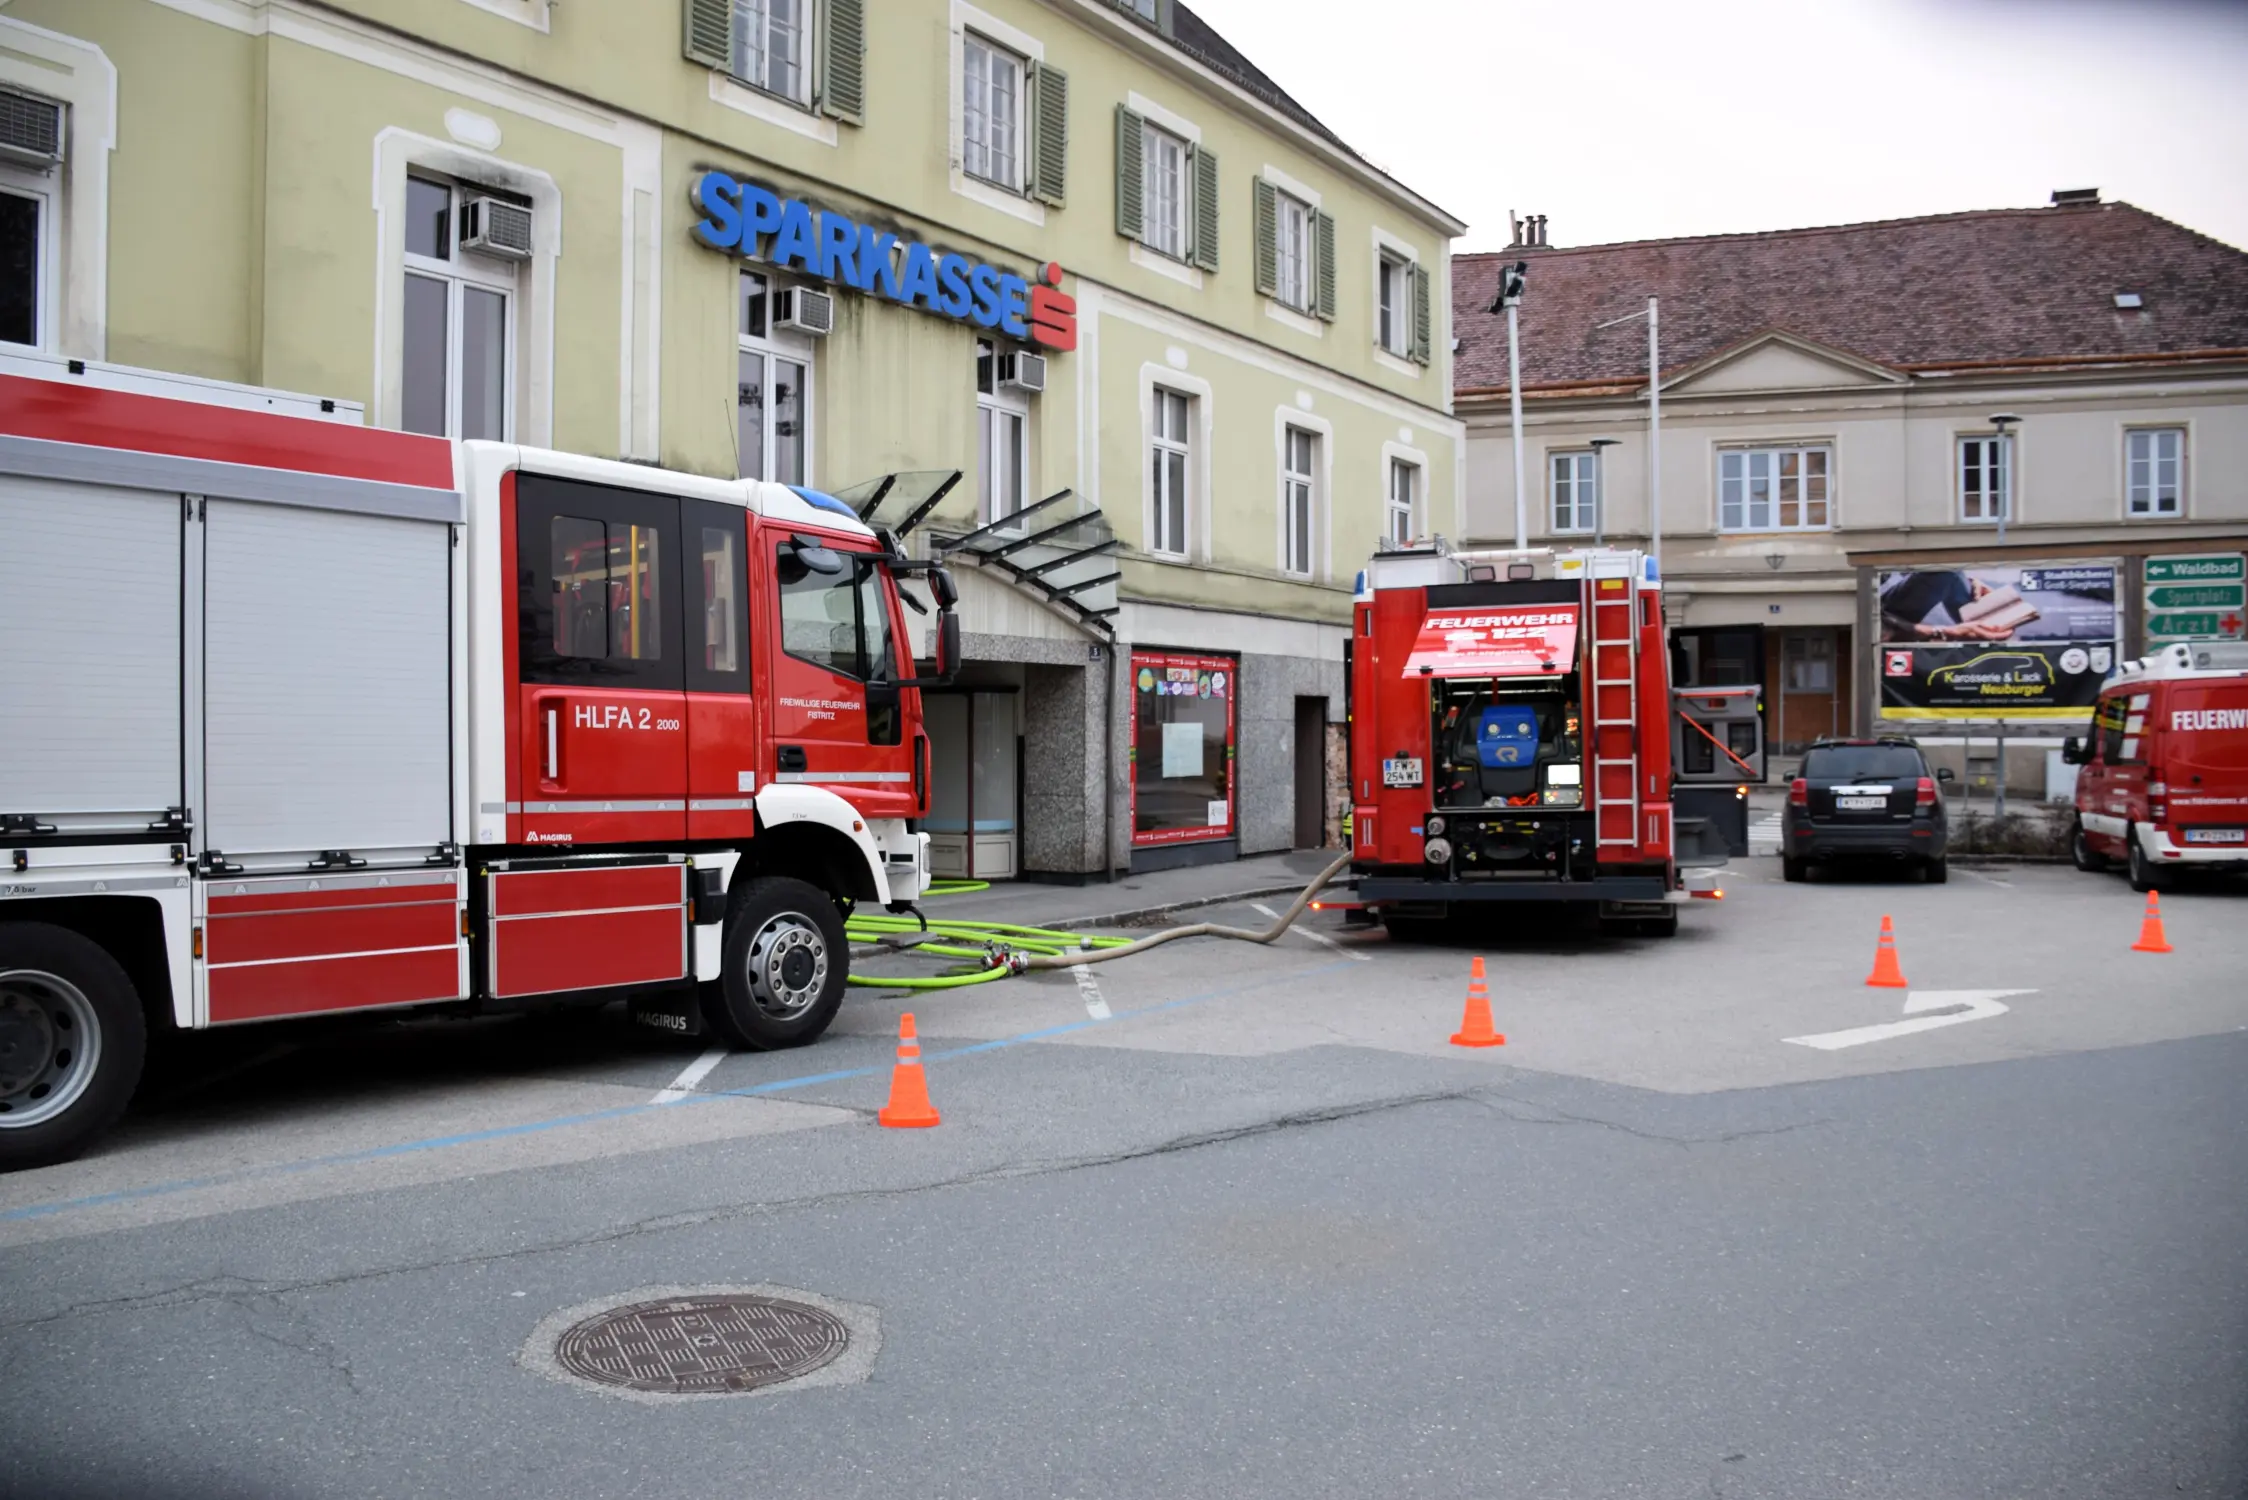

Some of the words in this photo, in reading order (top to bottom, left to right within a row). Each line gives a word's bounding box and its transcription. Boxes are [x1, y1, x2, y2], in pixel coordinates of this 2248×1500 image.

[698, 171, 1028, 337] SPARKASSE
[2171, 562, 2239, 576] Waldbad
[2167, 588, 2231, 606] Sportplatz
[1425, 613, 1574, 630] FEUERWEHR
[2161, 615, 2209, 633] Arzt
[1491, 626, 1549, 640] 122
[1944, 671, 2002, 683] Karosserie
[2003, 671, 2013, 683] &
[2014, 670, 2041, 683] Lack
[1980, 683, 2047, 697] Neuburger
[779, 697, 821, 708] FREIWILLIGE
[821, 700, 861, 711] FEUERWEHR
[575, 705, 634, 729] HLFA
[638, 708, 651, 730] 2
[656, 718, 680, 731] 2000
[807, 711, 836, 720] FISTRITZ
[2171, 709, 2248, 731] FEUERW
[1394, 760, 1408, 771] FW
[1386, 771, 1405, 782] 254
[1406, 770, 1420, 781] WT
[539, 833, 573, 842] MAGIRUS
[21, 885, 37, 893] bar
[636, 1010, 688, 1031] MAGIRUS
